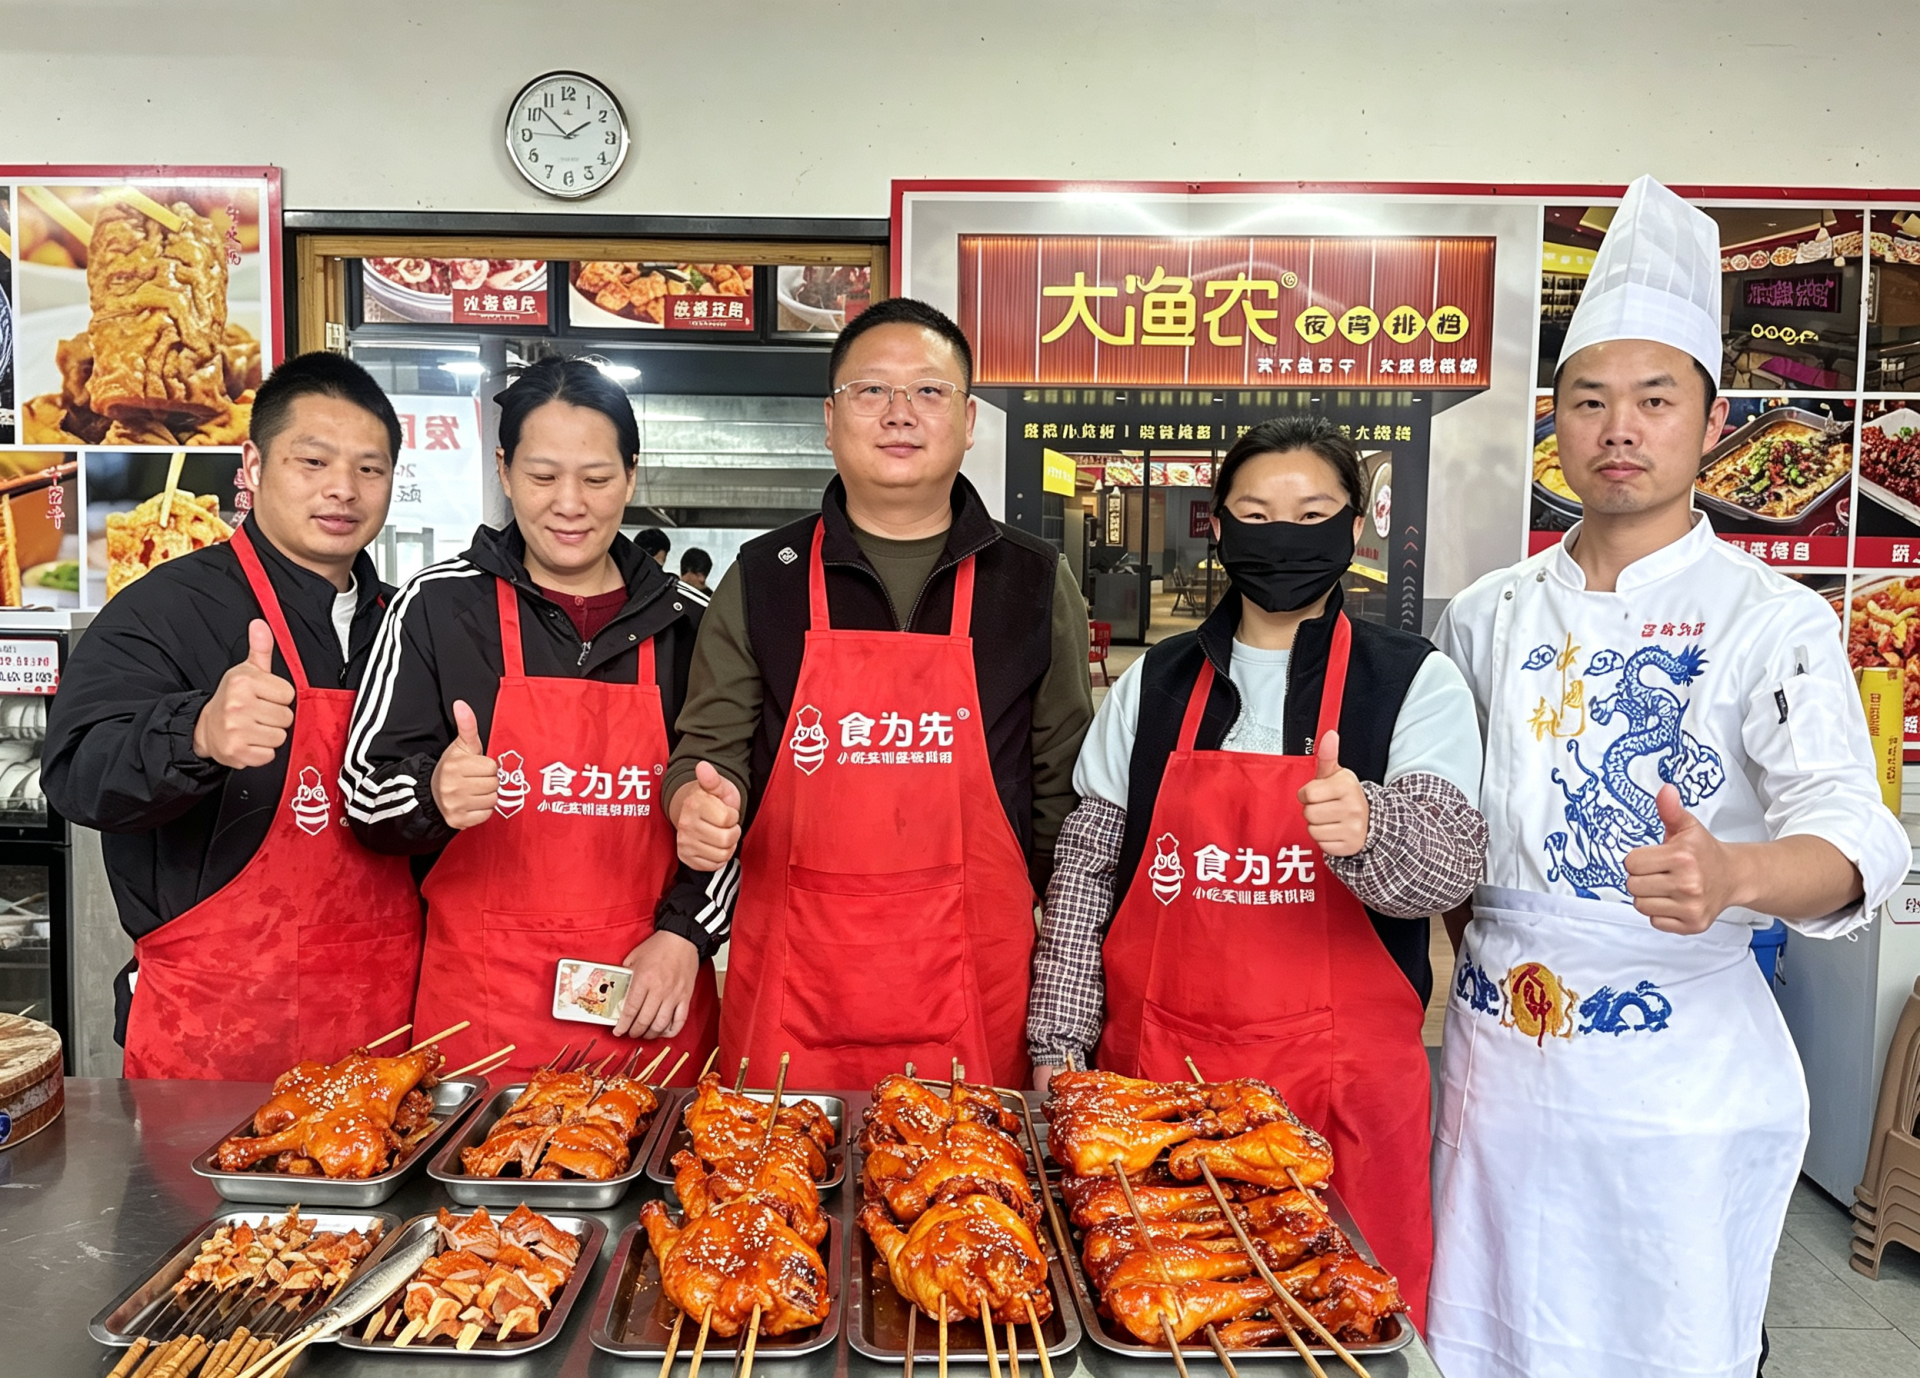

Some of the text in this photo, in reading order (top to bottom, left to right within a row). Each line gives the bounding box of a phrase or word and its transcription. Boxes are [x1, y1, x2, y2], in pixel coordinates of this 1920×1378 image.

[544, 92, 554, 108] 11
[561, 86, 576, 101] 12
[586, 95, 591, 109] 1
[527, 107, 542, 122] 10
[598, 110, 608, 123] 2
[544, 164, 554, 179] 7
[1041, 265, 1279, 346] 大渔农
[838, 711, 954, 748] 食为先
[539, 761, 651, 800] 食为先
[1193, 844, 1316, 885] 食为先
